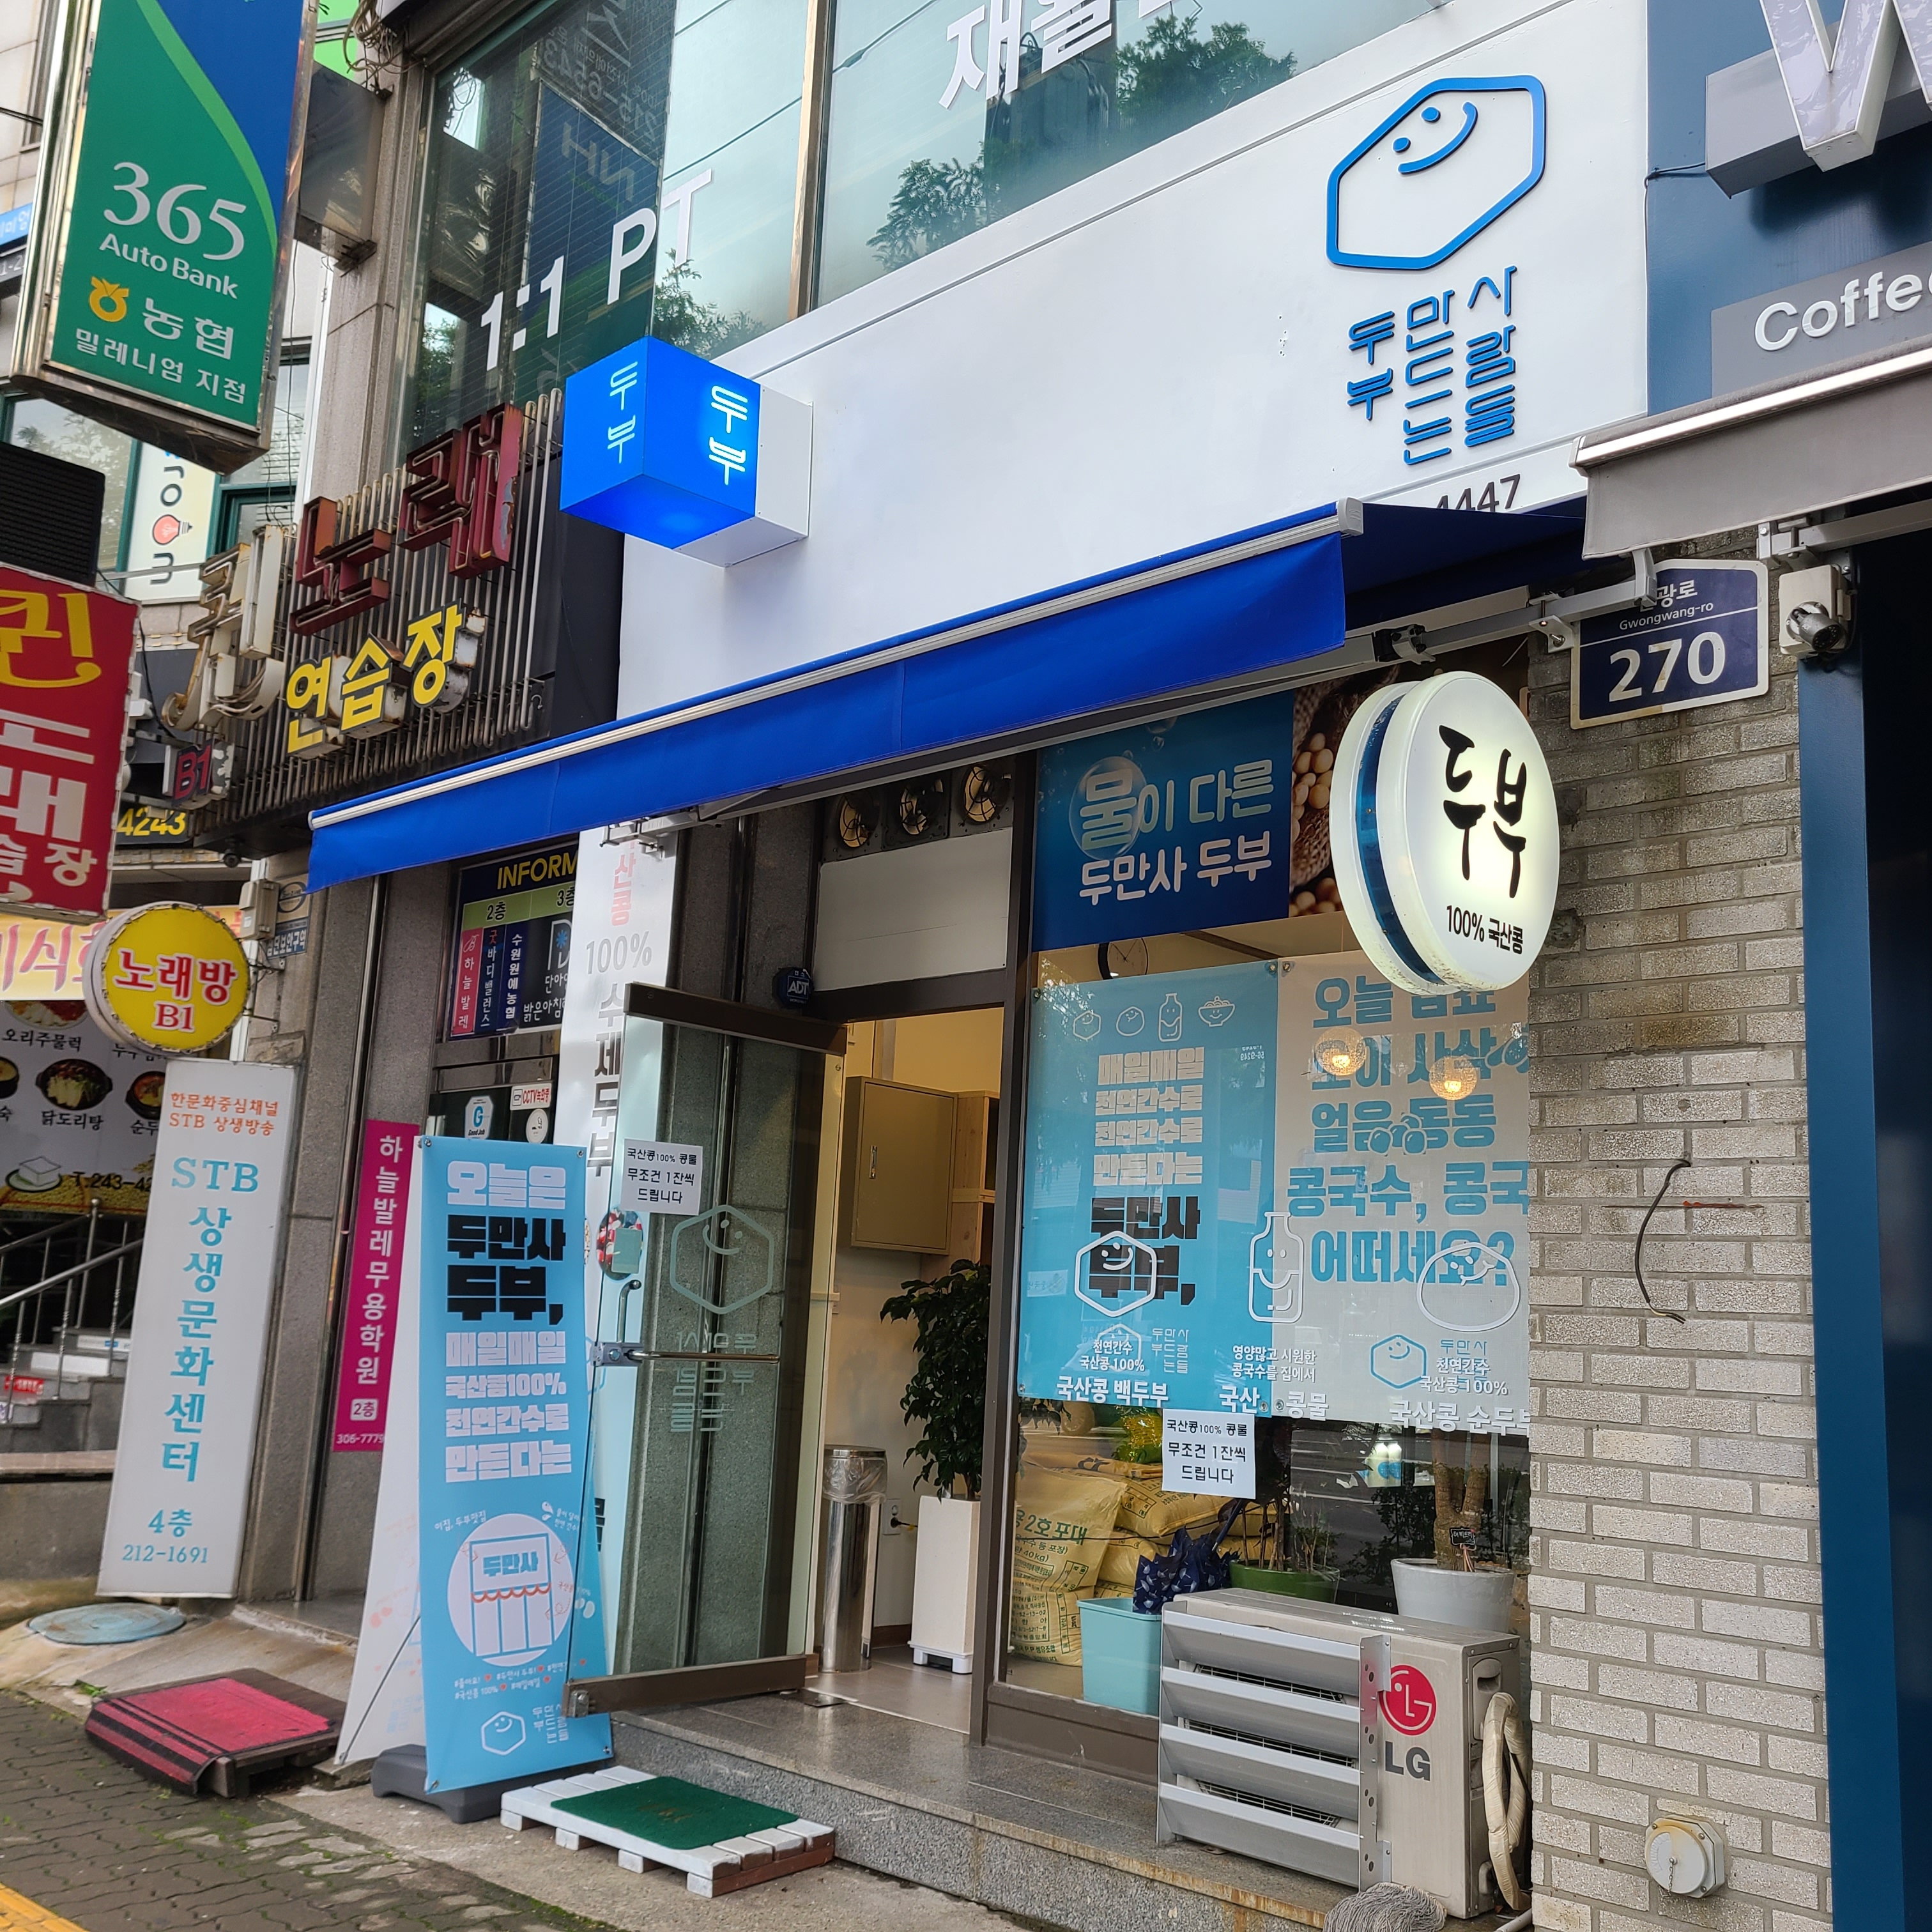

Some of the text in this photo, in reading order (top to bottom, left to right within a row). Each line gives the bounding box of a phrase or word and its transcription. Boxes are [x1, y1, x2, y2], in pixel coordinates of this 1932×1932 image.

[103, 162, 247, 261] 365
[99, 233, 238, 299] Auto Bank
[142, 297, 234, 360] 농협
[480, 256, 564, 371] 1:1
[1753, 272, 1932, 352] Coffe
[75, 328, 245, 404] 밀레니엄 지점
[607, 361, 638, 464] 두부
[709, 385, 748, 486] 두부
[1640, 578, 1699, 611] 광로
[1619, 601, 1715, 632] Gwongwang-ro
[286, 603, 466, 755] 연습장
[1608, 631, 1726, 703] 270
[174, 740, 212, 801] B1
[1080, 759, 1274, 851] 물이 다른
[1079, 831, 1272, 906] 두만사 두부
[487, 901, 506, 921] 2층
[1446, 904, 1524, 954] 100% 국산콩
[586, 930, 652, 975] 100%
[113, 949, 239, 1006] 노래방
[458, 957, 475, 1029] 하늘발레
[505, 933, 523, 1020] 수원원예농협
[788, 981, 809, 995] ADT
[153, 1000, 195, 1032] B1
[1313, 975, 1393, 1028] 오늘
[2, 1029, 82, 1053] 오리주물럭
[1098, 1046, 1204, 1085] 매일매일
[171, 1093, 279, 1117] 한문화중심채널
[1095, 1085, 1202, 1116] 천연간수로
[169, 1113, 275, 1136] STB 상생방송
[1094, 1117, 1202, 1147] 천연간수로
[627, 1147, 697, 1165] 국산콩100% 콩물
[1093, 1151, 1202, 1186] 만든다는
[171, 1158, 260, 1193] STB
[448, 1160, 565, 1209] 오늘은
[627, 1168, 661, 1184] 무조건
[637, 1188, 683, 1204] 드립니다
[1287, 1165, 1427, 1223] 콩국수,
[1091, 1195, 1201, 1240] 두만사
[447, 1215, 565, 1261] 두만사
[355, 1135, 404, 1385] 하늘발레무용학원
[161, 1207, 233, 1482] 상생문화센터
[446, 1331, 566, 1367] 매일매일
[1233, 1345, 1317, 1365] 영양많고 시원한
[1080, 1355, 1145, 1372] 국산콩 100%
[1232, 1363, 1315, 1383] 콩국수를 집에서
[446, 1372, 567, 1399] 국산콩100%
[1057, 1376, 1169, 1408] 국산콩 백두부
[1219, 1386, 1328, 1420] 국산 콩물
[1420, 1376, 1508, 1395] 국산콩 100%
[353, 1401, 376, 1418] 2층
[446, 1403, 569, 1438] 천연간수로
[1390, 1400, 1460, 1432] 국산콩
[1167, 1419, 1248, 1437] 국산콩100% 콩물
[446, 1439, 572, 1483] 만든다는
[1169, 1442, 1206, 1460] 무조건
[1181, 1465, 1234, 1484] 드립니다
[148, 1509, 193, 1538] 4층
[122, 1544, 208, 1564] 212-1691
[483, 1551, 539, 1577] 두만사
[1385, 1740, 1431, 1782] LG
